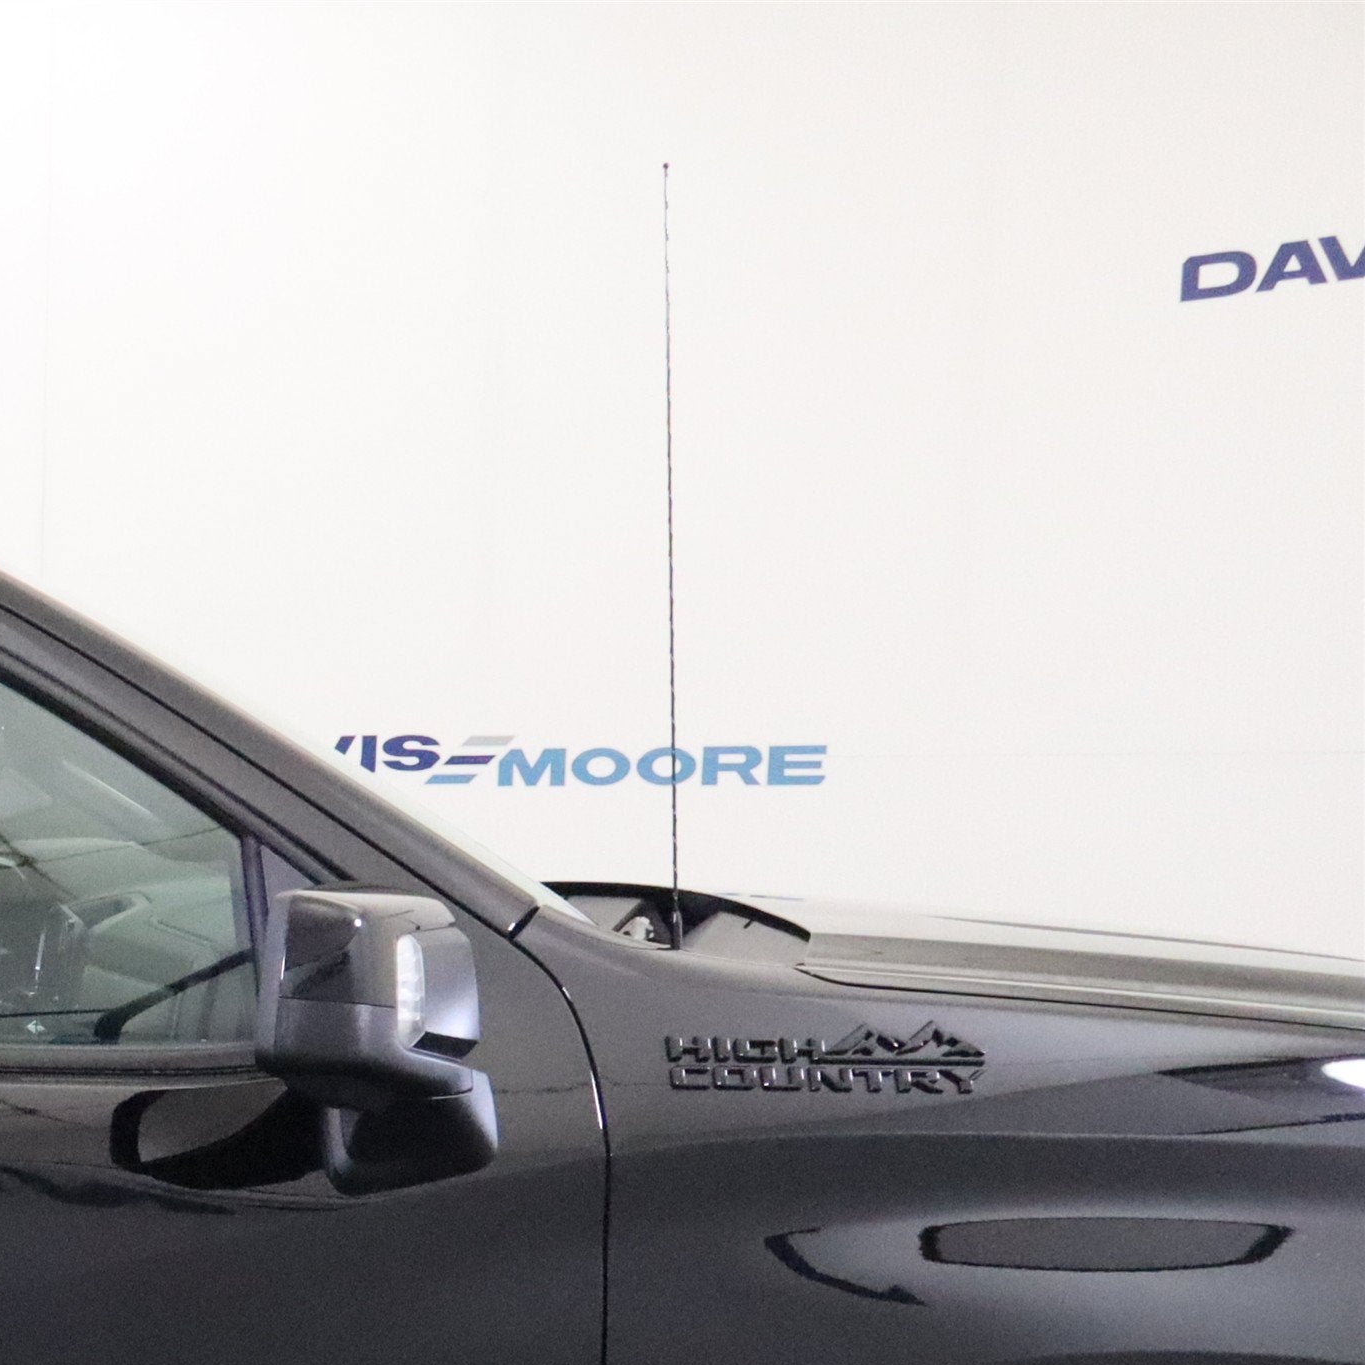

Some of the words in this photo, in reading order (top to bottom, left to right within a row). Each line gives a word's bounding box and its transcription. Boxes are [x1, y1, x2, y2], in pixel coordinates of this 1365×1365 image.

[496, 744, 828, 788] MOORE
[664, 1036, 826, 1064] HIGH
[670, 1064, 986, 1094] COUNTRY
